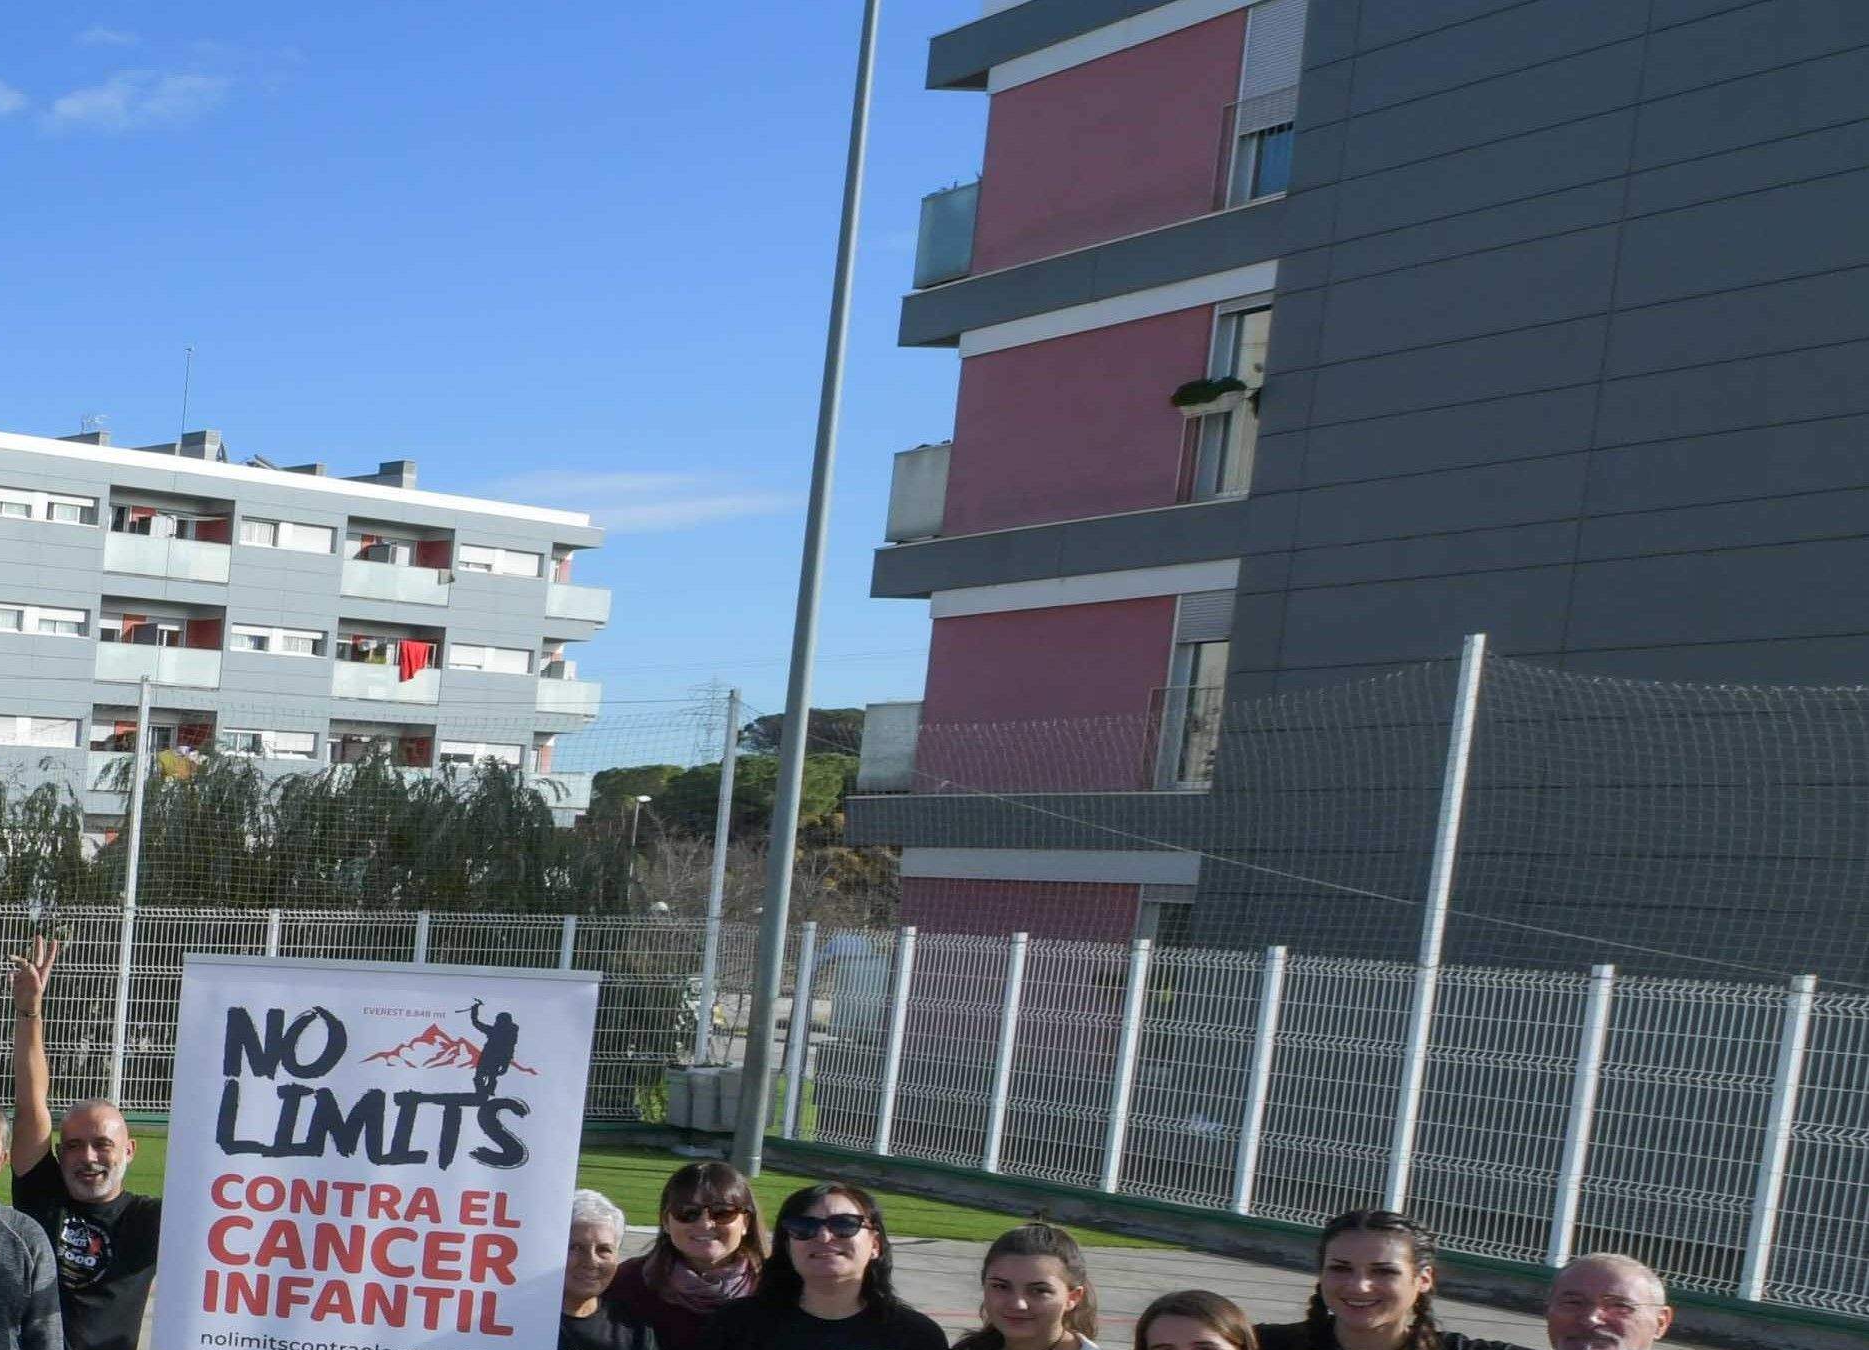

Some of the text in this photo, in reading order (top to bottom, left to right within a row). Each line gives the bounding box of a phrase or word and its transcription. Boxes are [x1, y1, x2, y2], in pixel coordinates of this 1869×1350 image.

[223, 1006, 348, 1080] NO
[216, 1078, 531, 1170] LIMITS
[211, 1173, 521, 1229] CONTRA EL
[207, 1215, 519, 1286] CANCER
[203, 1269, 514, 1336] INFANTIL
